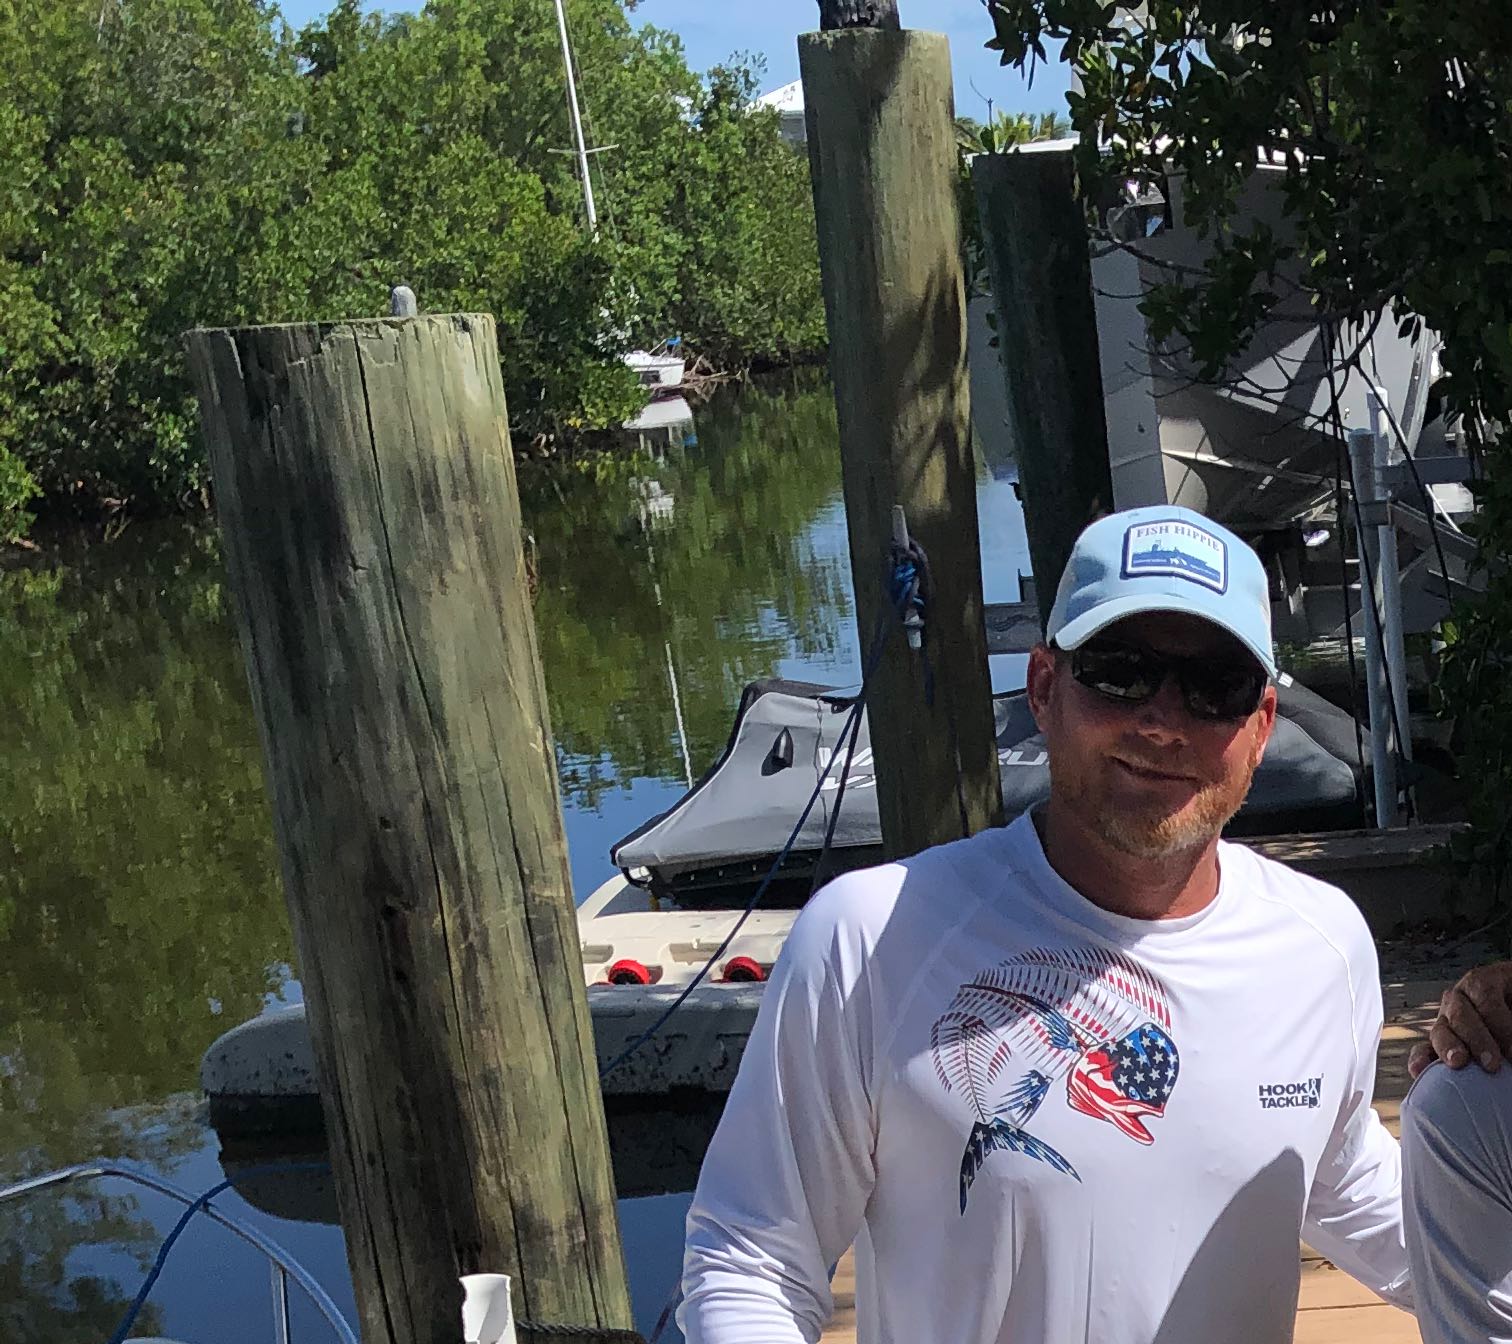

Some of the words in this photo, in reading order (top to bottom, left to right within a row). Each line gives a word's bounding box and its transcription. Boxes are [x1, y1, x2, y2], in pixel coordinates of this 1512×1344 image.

[1136, 525, 1170, 538] FISH
[1258, 1082, 1308, 1097] HOOK
[1259, 1095, 1309, 1109] TACKLE
